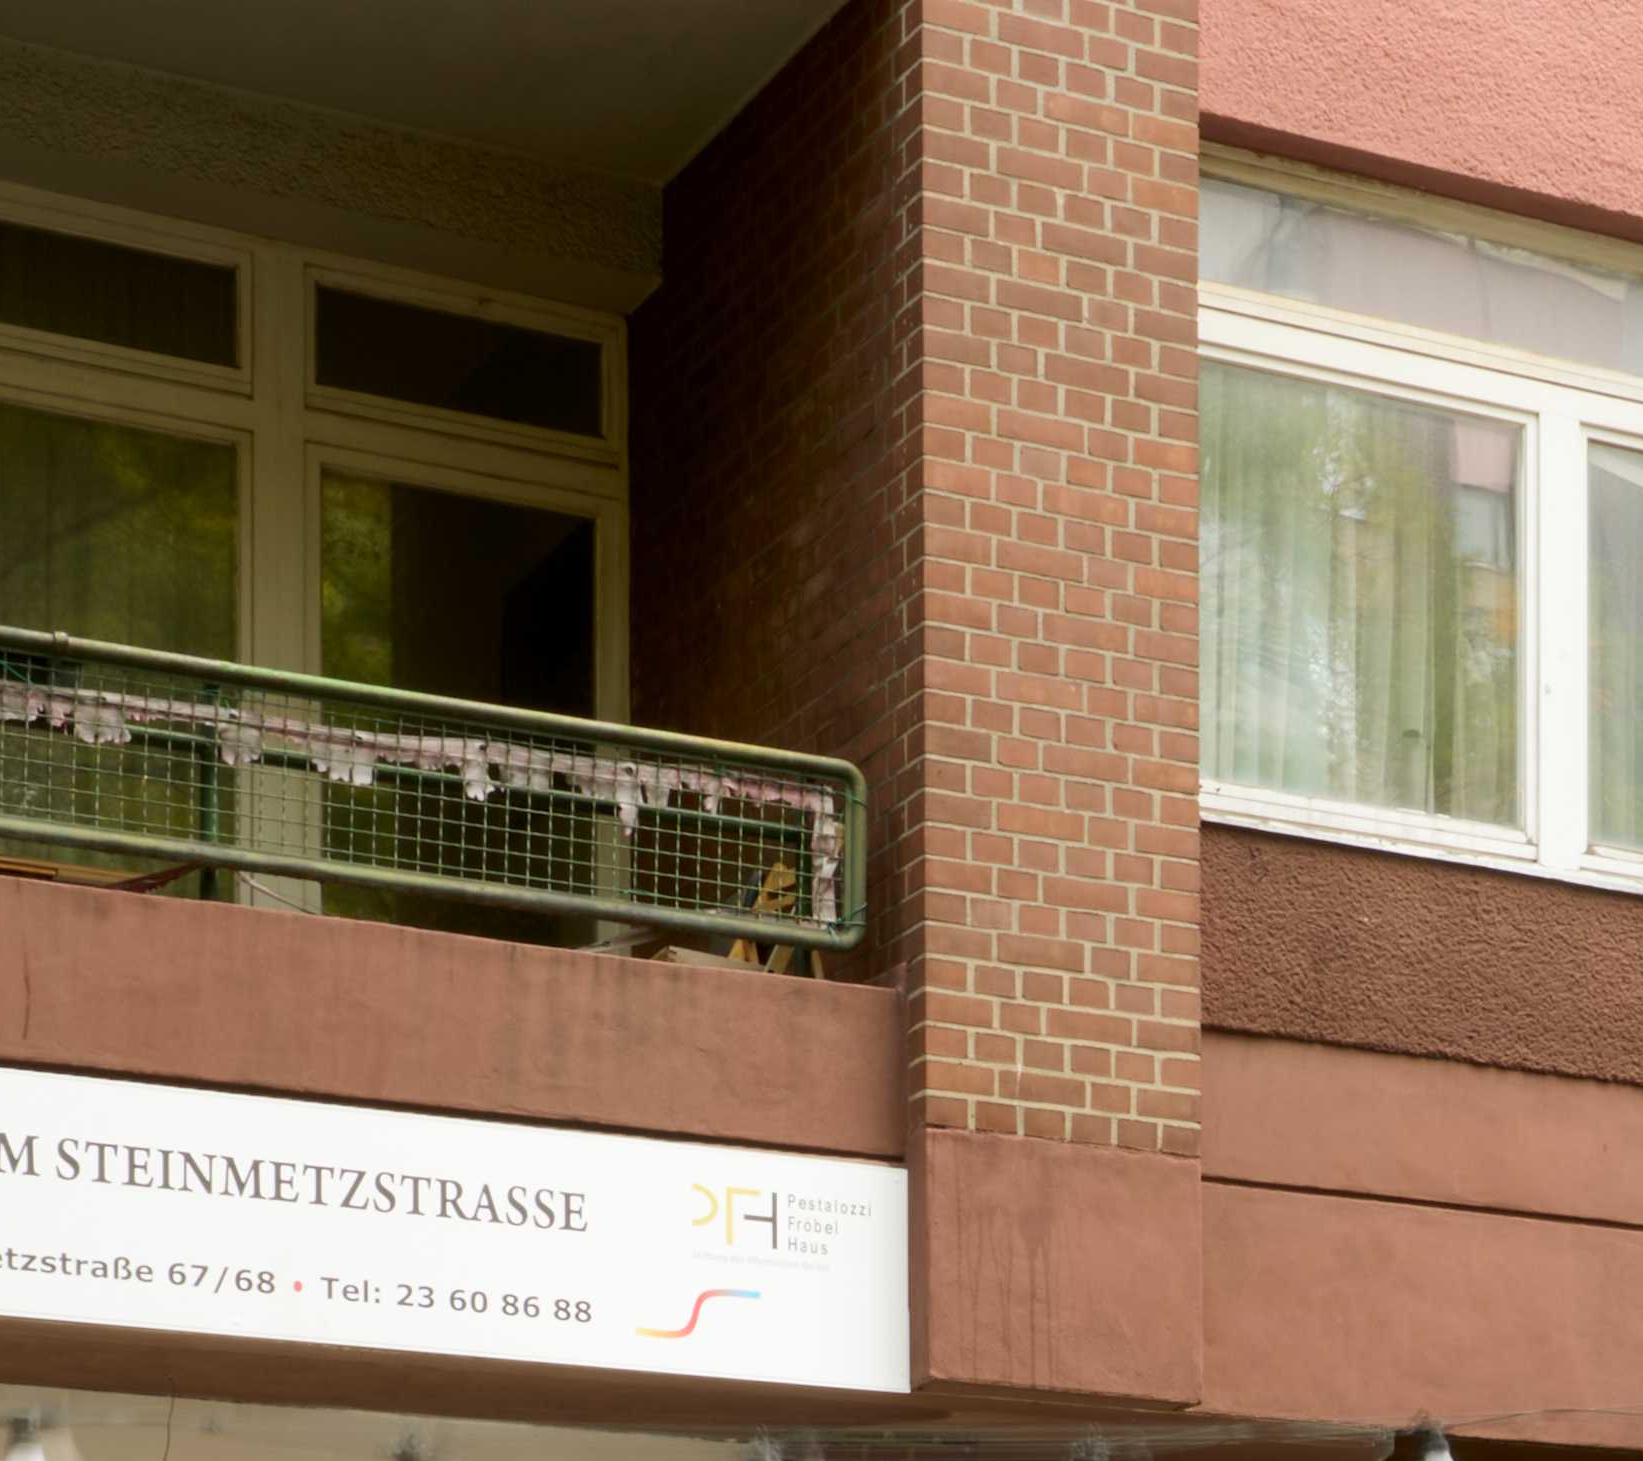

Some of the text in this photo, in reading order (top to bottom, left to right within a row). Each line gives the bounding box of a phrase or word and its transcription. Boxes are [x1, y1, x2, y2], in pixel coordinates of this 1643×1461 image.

[55, 1137, 590, 1233] STEINMETZSTRASSE
[787, 1194, 872, 1217] Pestalozzi
[787, 1237, 829, 1256] Haus
[167, 1263, 276, 1296] 67/68
[320, 1276, 382, 1305] Tel:
[396, 1283, 436, 1310] 23
[449, 1288, 489, 1315] 60
[500, 1292, 541, 1320] 86
[553, 1297, 593, 1324] 88
